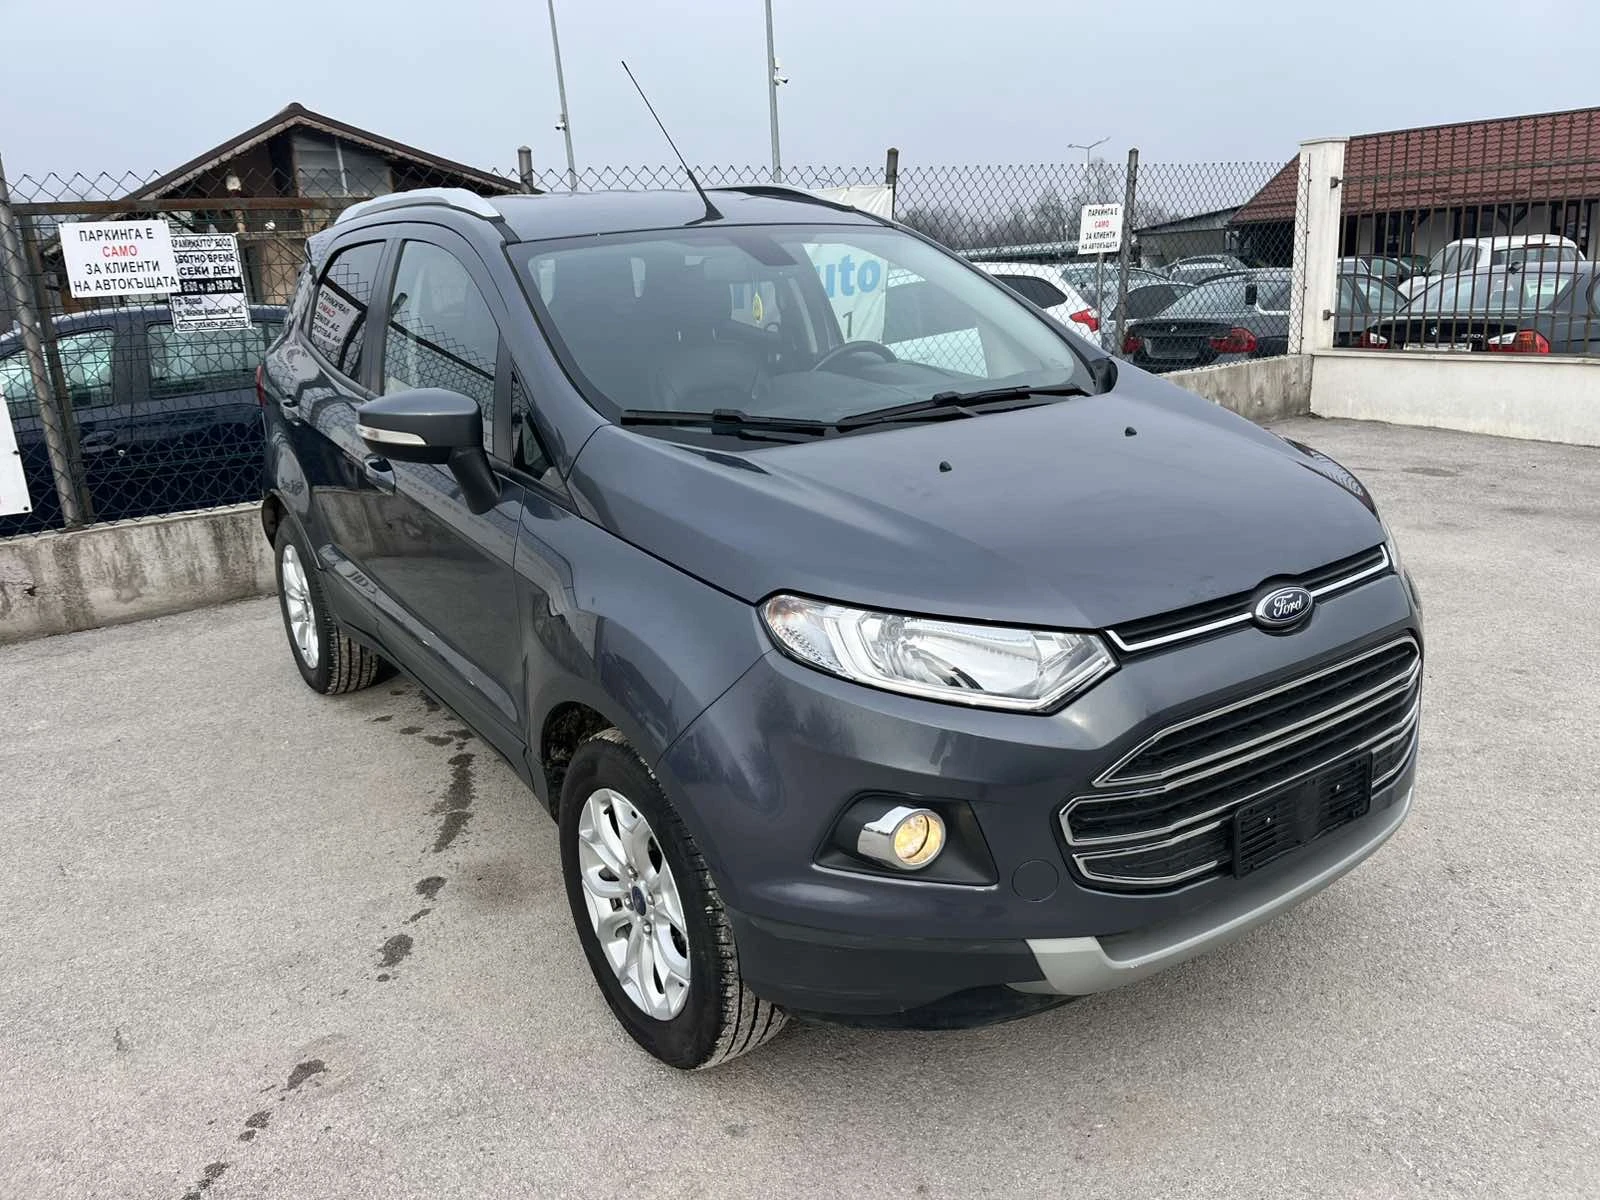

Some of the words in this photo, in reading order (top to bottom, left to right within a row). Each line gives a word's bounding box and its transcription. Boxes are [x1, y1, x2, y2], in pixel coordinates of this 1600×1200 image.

[1088, 208, 1114, 216] ПАРКИНГА
[1114, 208, 1118, 216] Е
[1094, 220, 1110, 228] САМО
[79, 228, 142, 242] ПАРКИНГА
[146, 228, 154, 240] Е
[1086, 232, 1092, 240] ЗА
[1094, 231, 1116, 240] КЛИЕНТИ
[102, 245, 138, 258] САМО
[208, 253, 234, 263] ВРЕМЕ
[85, 263, 102, 275] ЗА
[104, 260, 160, 274] КЛИЕНТИ
[180, 266, 209, 276] СЕКИ
[213, 265, 236, 276] ДЕН
[816, 254, 880, 298] uto
[74, 280, 92, 292] НА
[95, 276, 178, 291] АВТОКЪЩАТА
[1273, 593, 1303, 618] Ford
